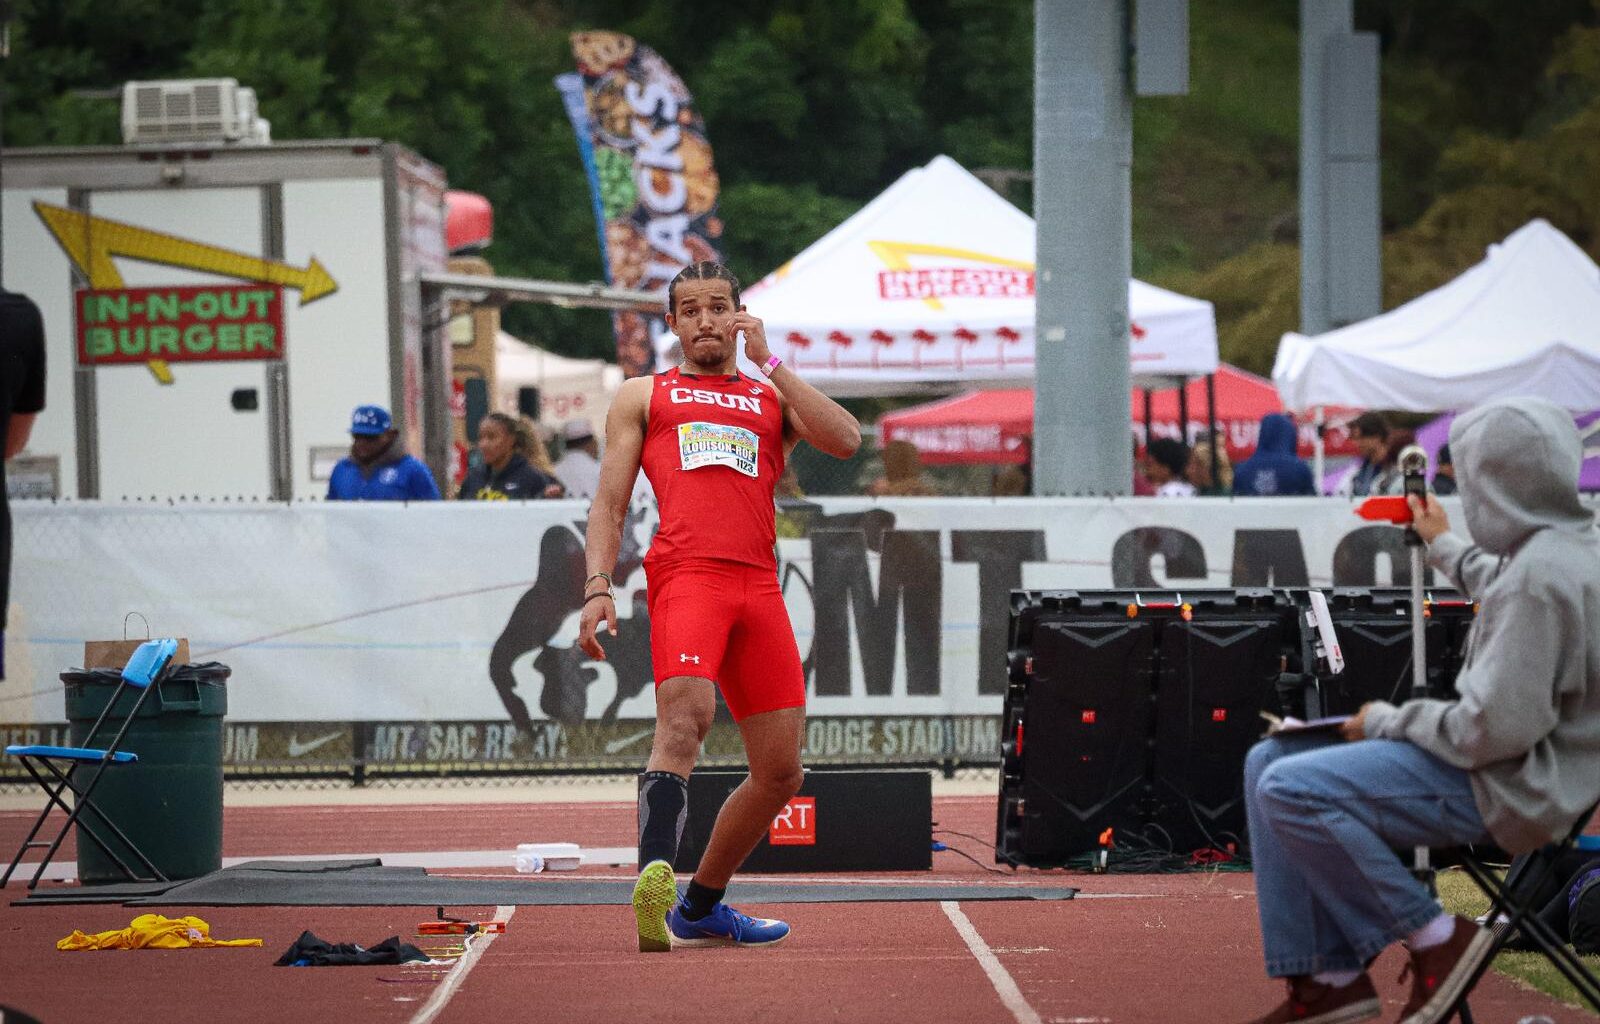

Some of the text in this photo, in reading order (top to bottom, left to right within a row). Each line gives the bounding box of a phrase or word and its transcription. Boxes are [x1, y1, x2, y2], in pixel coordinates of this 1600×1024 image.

[626, 79, 695, 350] ACKS
[83, 290, 275, 322] IN-N-OUT
[84, 322, 276, 355] BURGER
[670, 387, 762, 415] CSUN
[736, 458, 754, 473] 1123
[426, 724, 477, 760] SAC
[801, 718, 999, 754] ODGE STADIUM
[774, 804, 812, 828] RT
